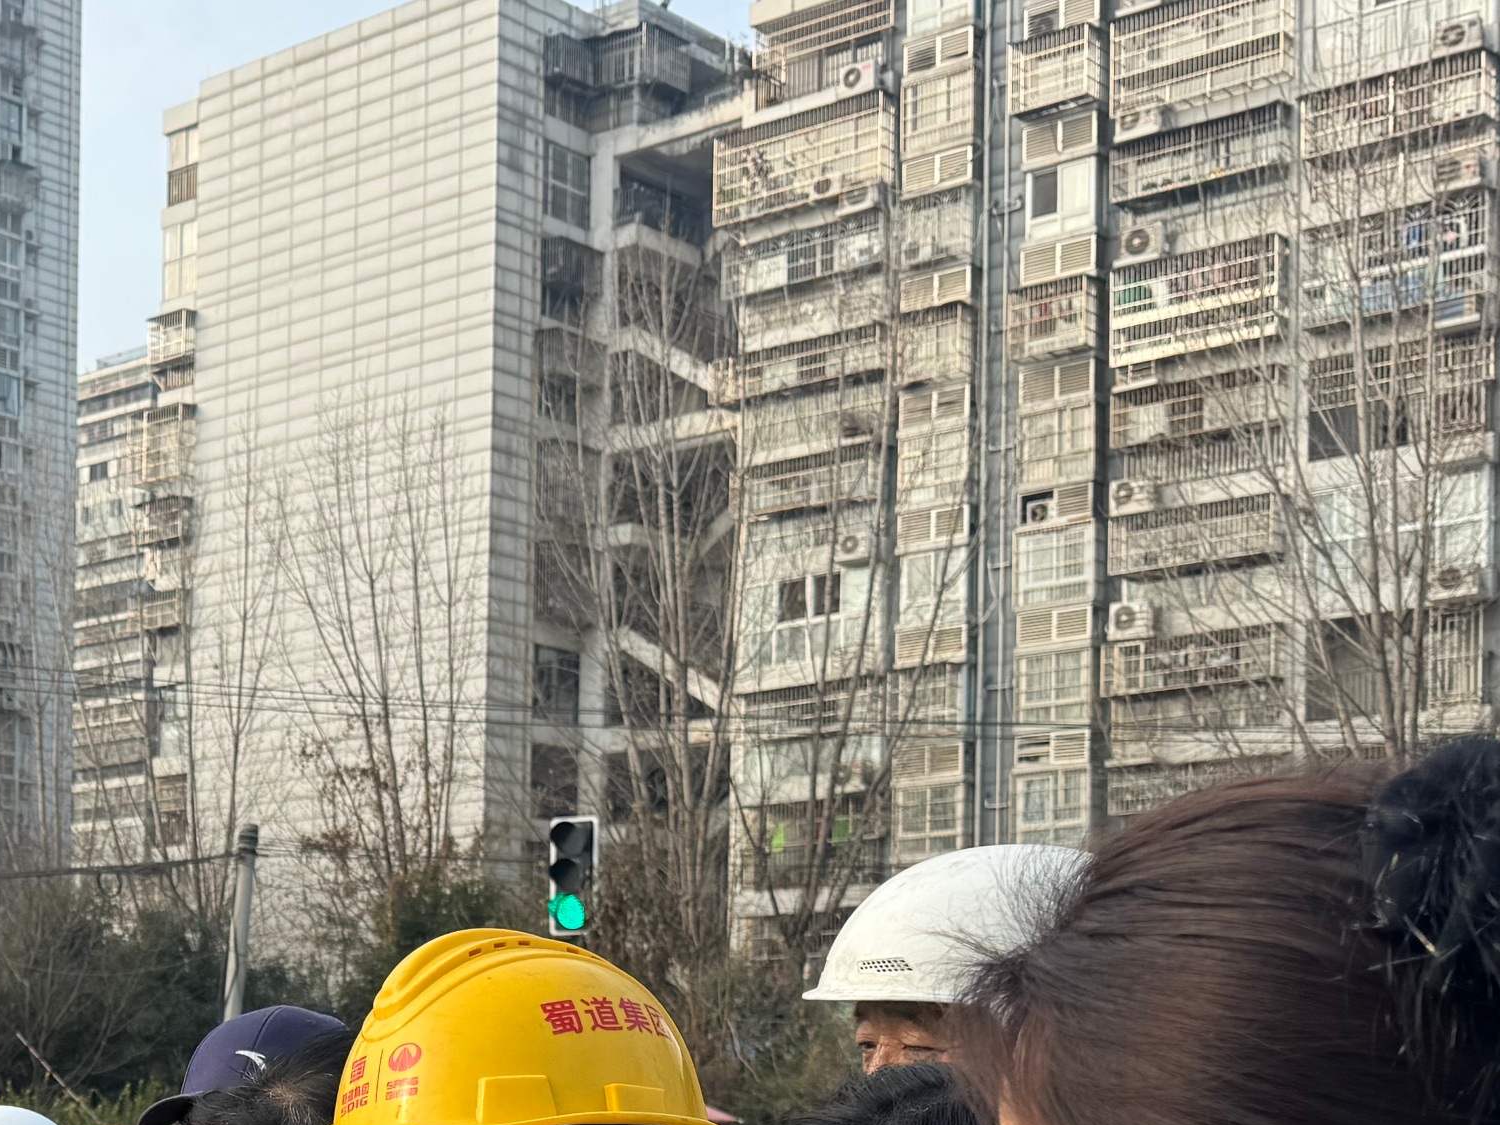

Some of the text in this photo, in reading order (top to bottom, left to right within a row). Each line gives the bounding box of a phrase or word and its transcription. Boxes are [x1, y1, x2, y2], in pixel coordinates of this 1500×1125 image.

[540, 997, 672, 1039] 蜀道集团
[341, 1096, 368, 1118] SDIG
